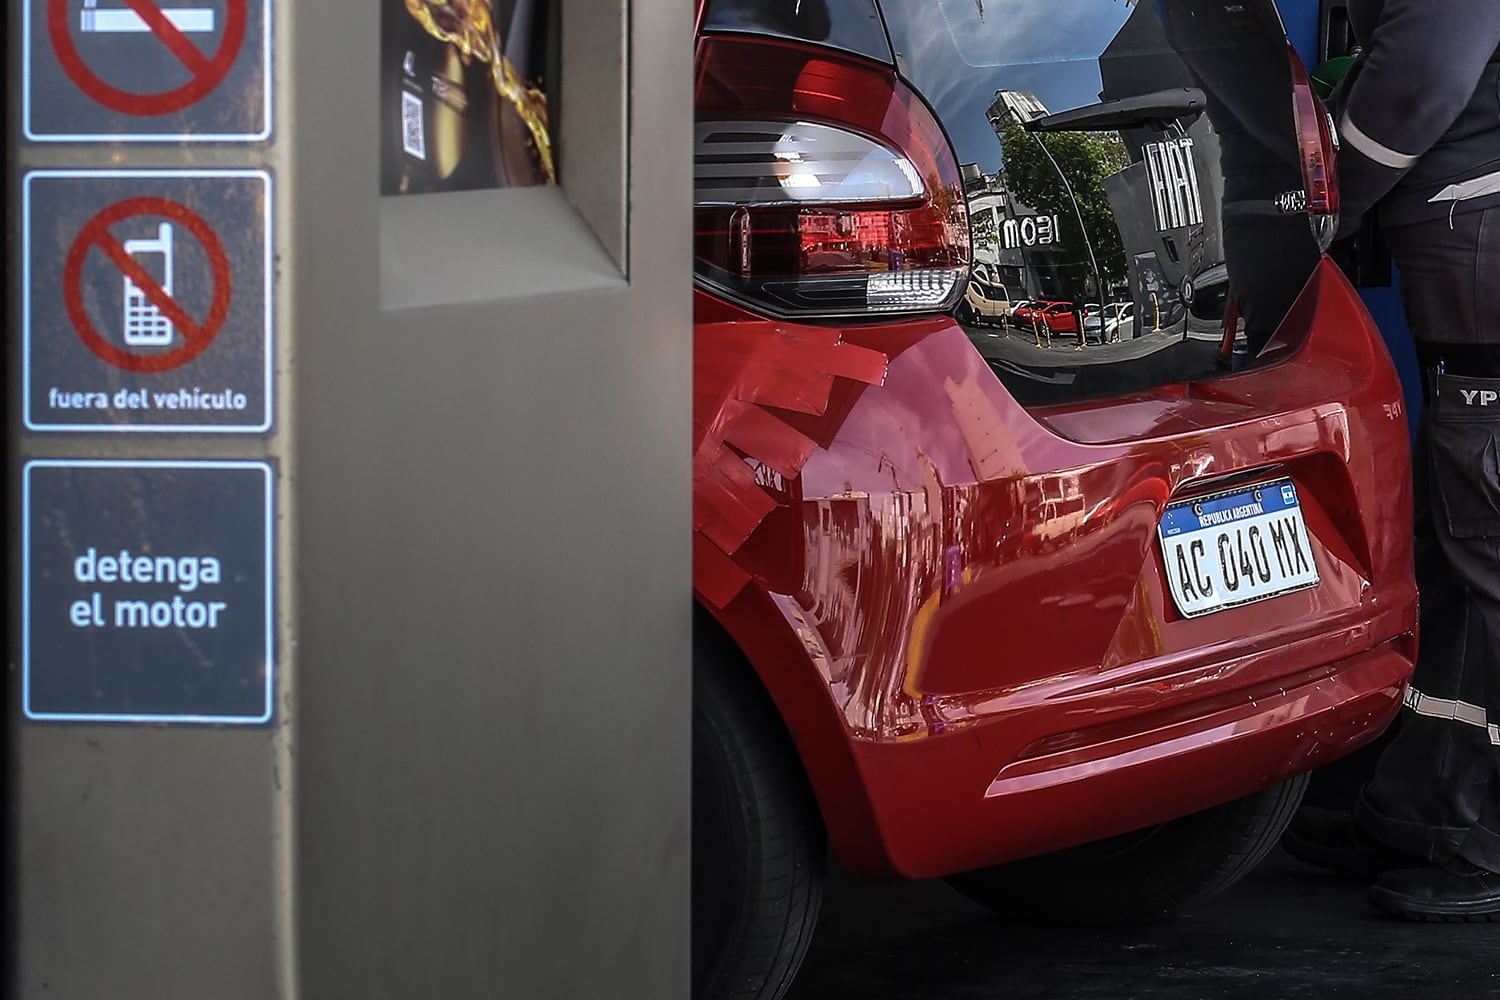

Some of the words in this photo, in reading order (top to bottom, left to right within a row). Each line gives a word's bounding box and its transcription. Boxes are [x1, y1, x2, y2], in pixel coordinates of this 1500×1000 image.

[50, 388, 108, 409] fuera
[113, 388, 149, 409] del
[1232, 503, 1264, 521] ARGENTINA
[74, 548, 220, 592] detenga
[1176, 539, 1213, 602] AC
[1218, 525, 1271, 591] 040
[1269, 515, 1310, 578] MX
[70, 592, 105, 627] el
[114, 596, 227, 628] motor
